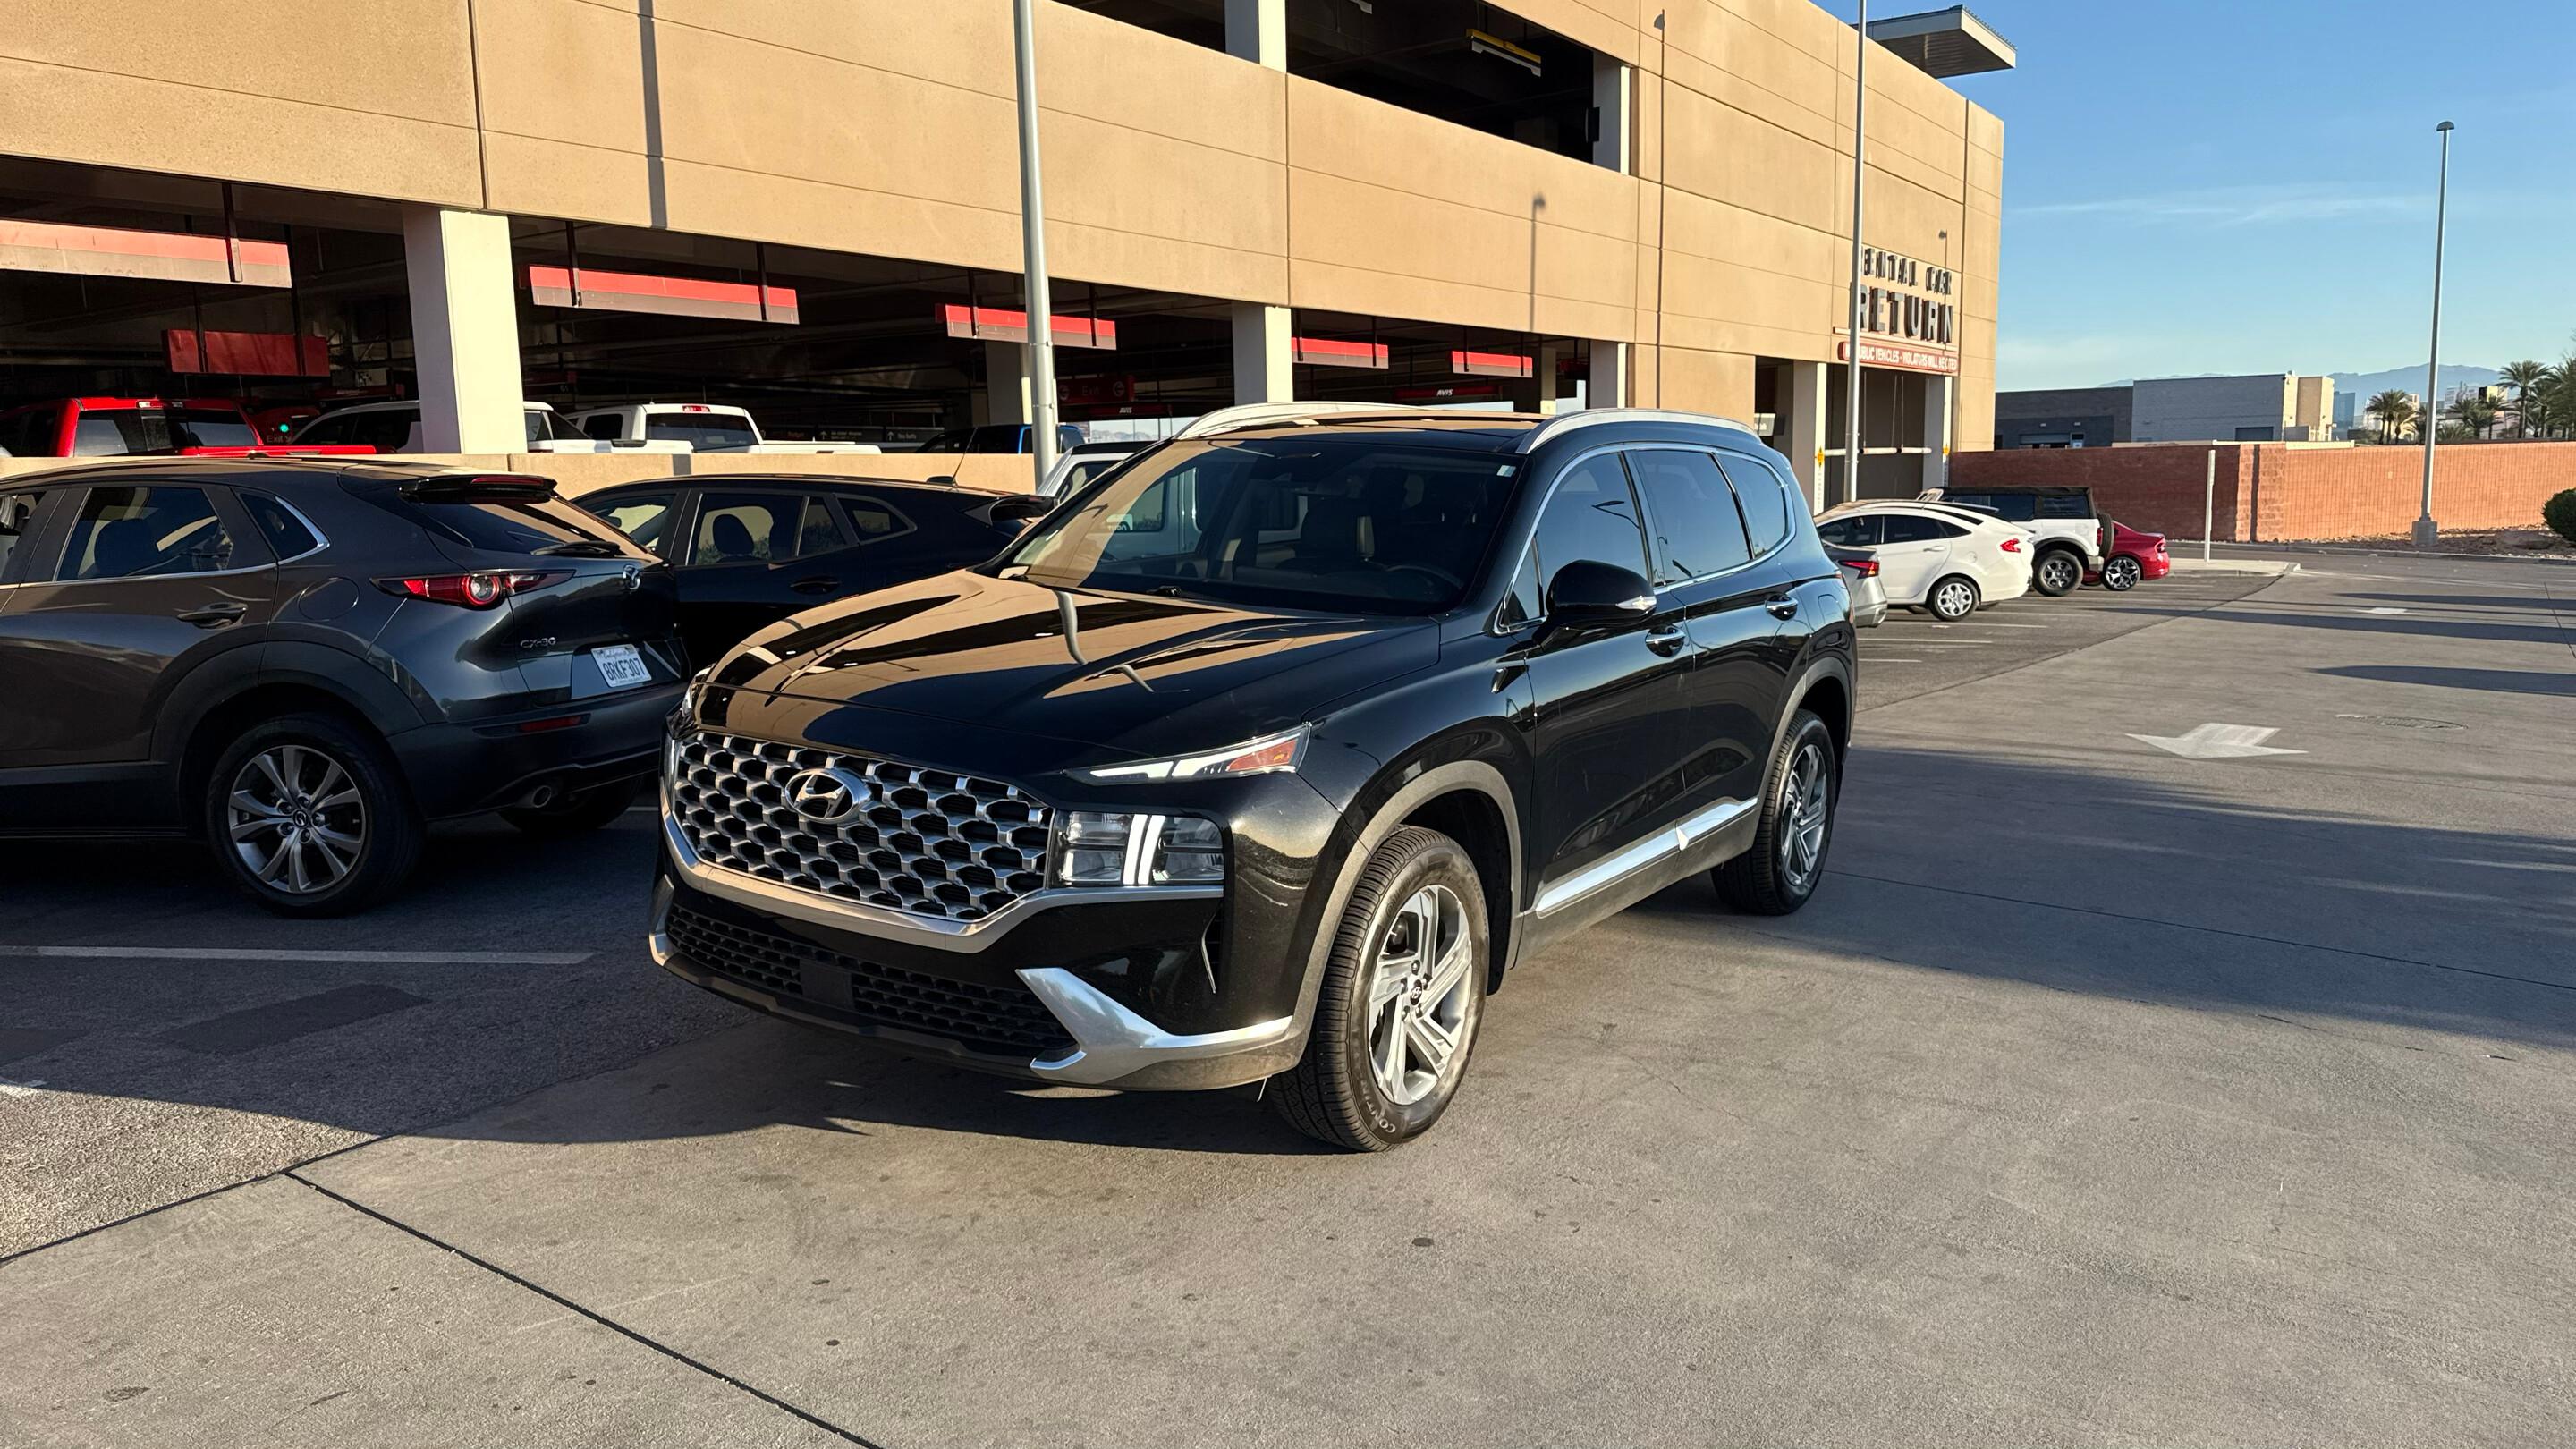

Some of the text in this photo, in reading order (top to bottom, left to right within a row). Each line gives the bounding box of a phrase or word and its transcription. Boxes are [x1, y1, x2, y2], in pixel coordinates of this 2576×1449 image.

[1860, 246, 1953, 296] ENTAL CAR
[1875, 347, 1900, 363] VEHICLES
[1902, 351, 1928, 368] VIOLATORS
[1928, 355, 1938, 369] WILL
[1436, 388, 1453, 397] AVIS
[1119, 406, 1133, 414] AVIS
[266, 434, 284, 444] Exit
[602, 657, 646, 681] 8RKF307
